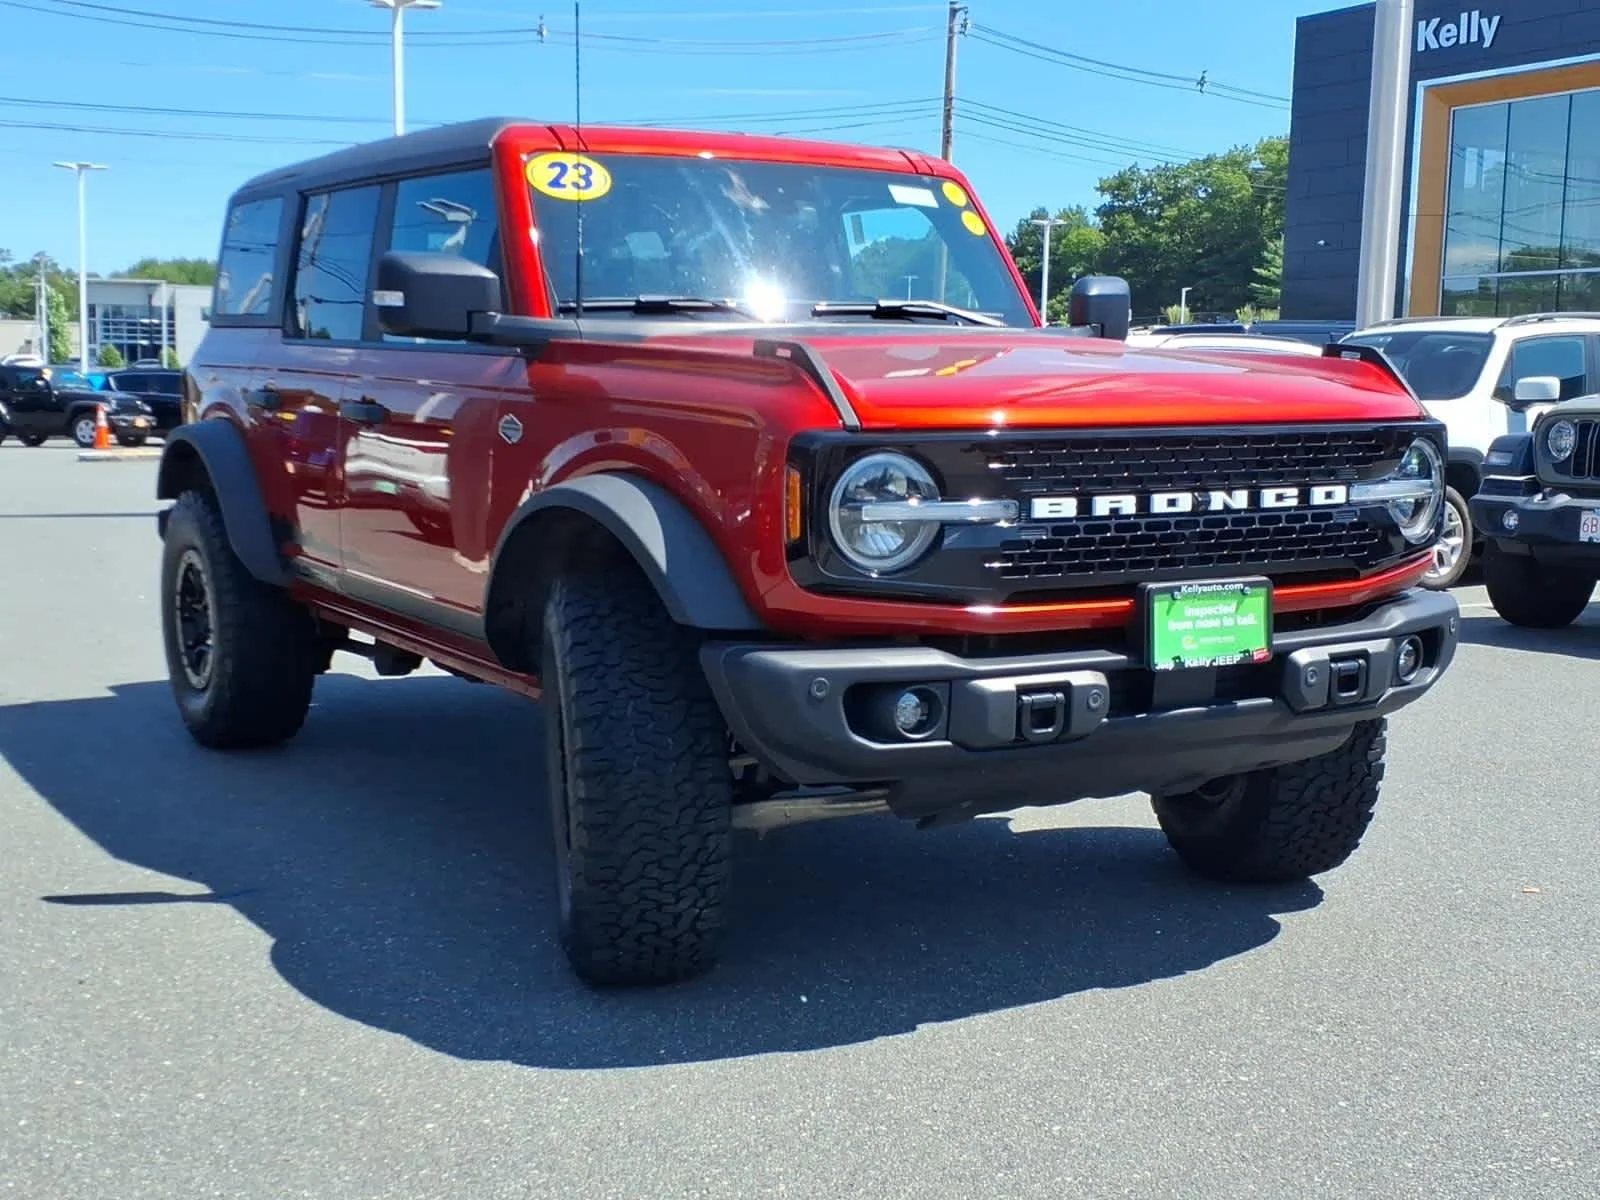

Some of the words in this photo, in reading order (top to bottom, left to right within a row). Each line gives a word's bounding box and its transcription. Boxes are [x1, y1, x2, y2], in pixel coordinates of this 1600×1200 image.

[1417, 10, 1501, 52] Kelly
[547, 161, 594, 191] 23
[1030, 484, 1348, 519] BRONCO
[1181, 583, 1244, 594] Kellyauto.com
[1185, 603, 1236, 617] Inspected
[1222, 616, 1235, 627] to
[1184, 656, 1211, 668] Kelly
[1213, 653, 1241, 667] JEEP
